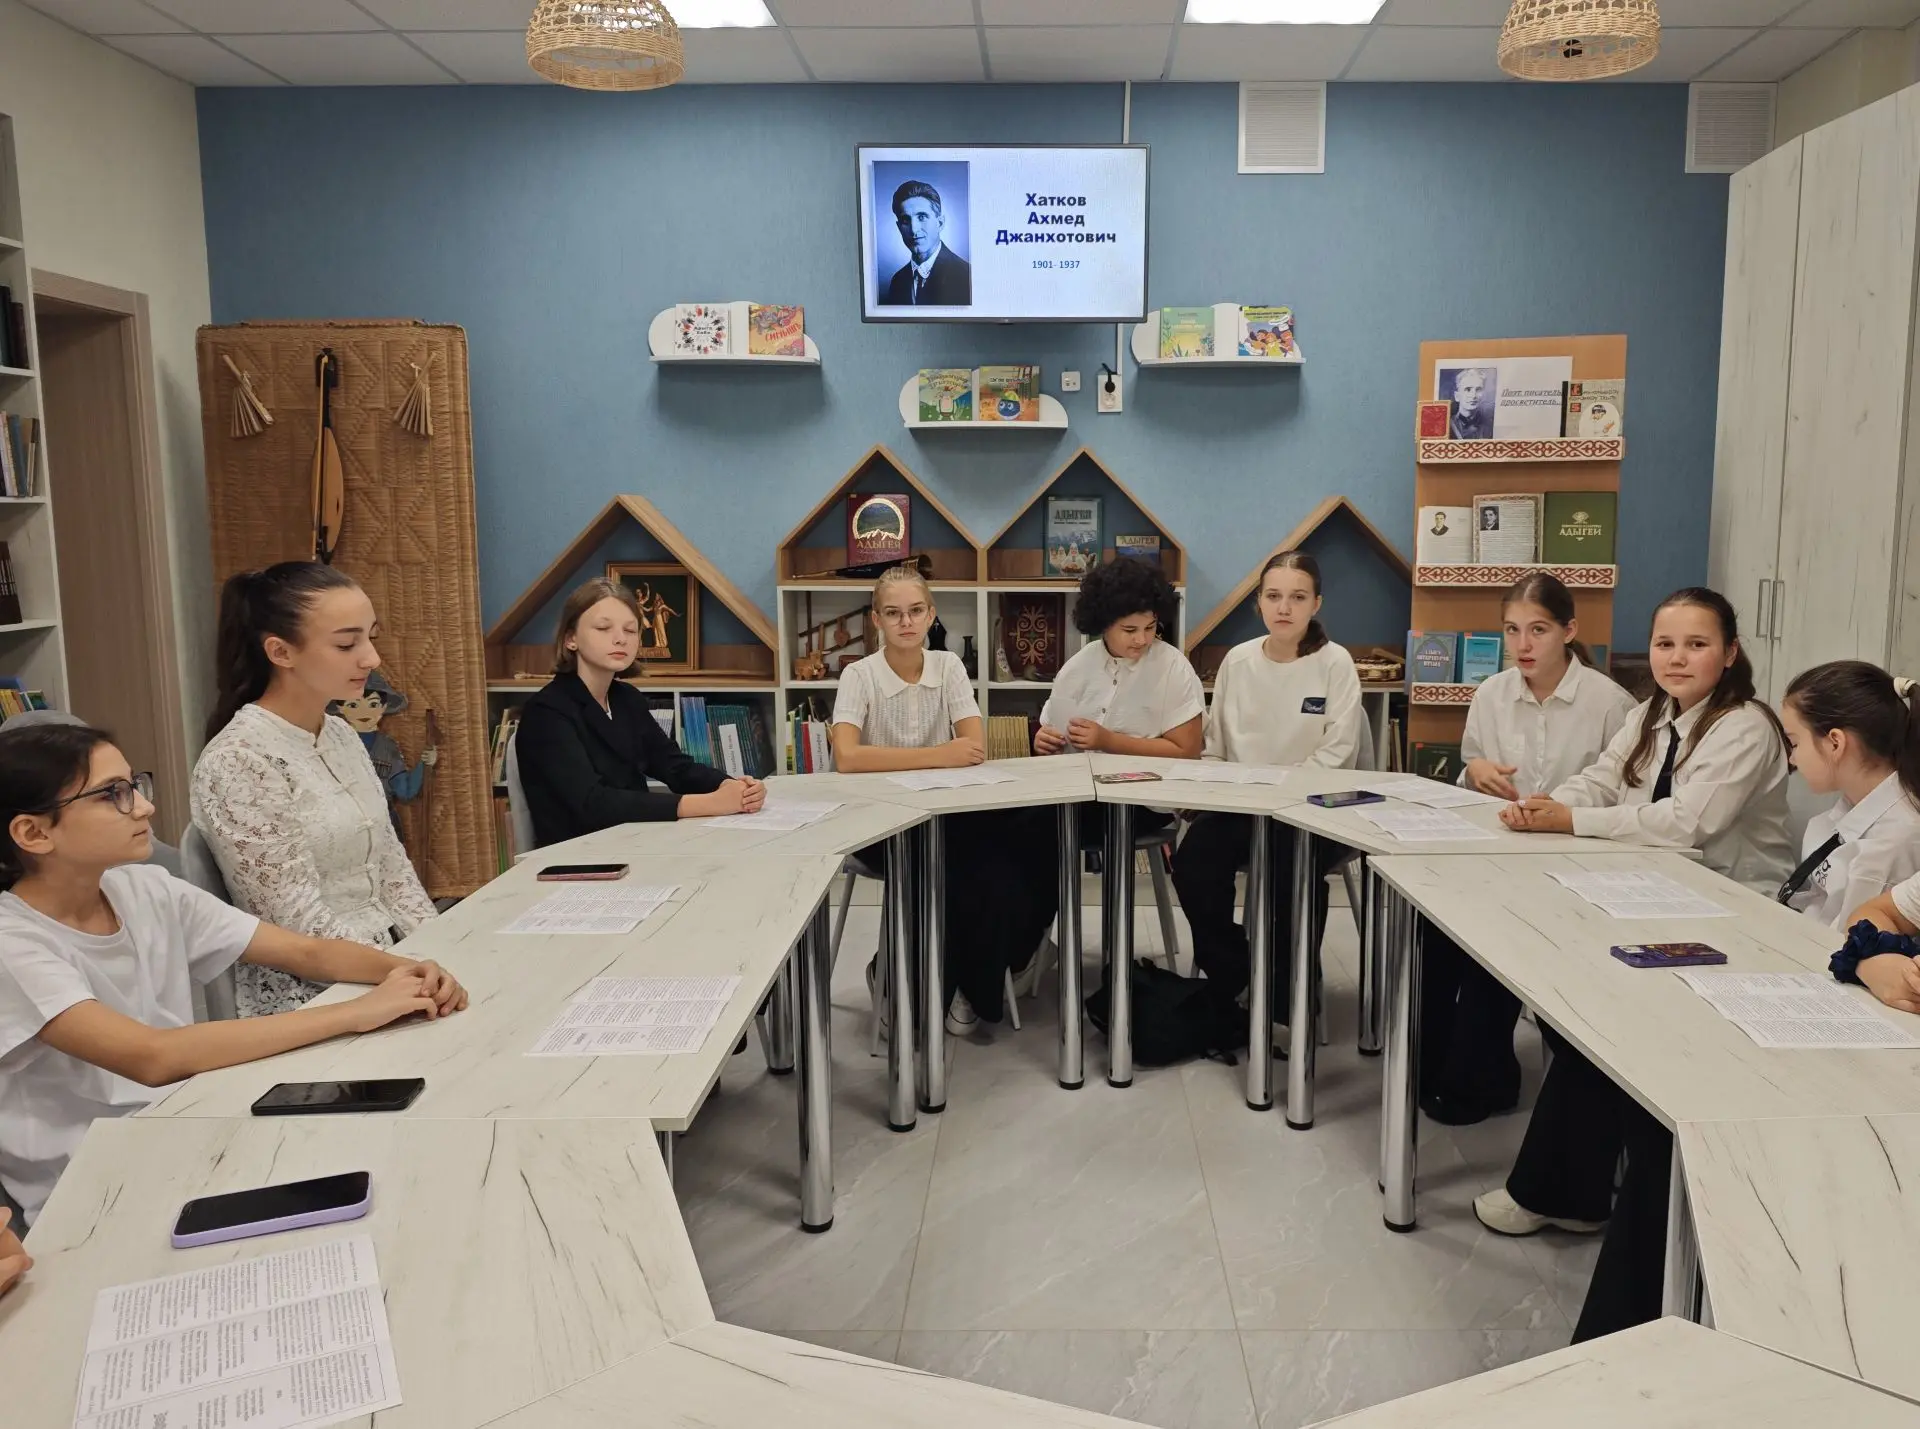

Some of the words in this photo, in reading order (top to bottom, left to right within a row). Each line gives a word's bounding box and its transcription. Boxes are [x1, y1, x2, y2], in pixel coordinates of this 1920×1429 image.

[1025, 193, 1087, 207] Хатков
[1027, 211, 1085, 227] Ахмед
[995, 229, 1117, 246] Джанхотович
[856, 539, 902, 550] АДЫГЕЯ
